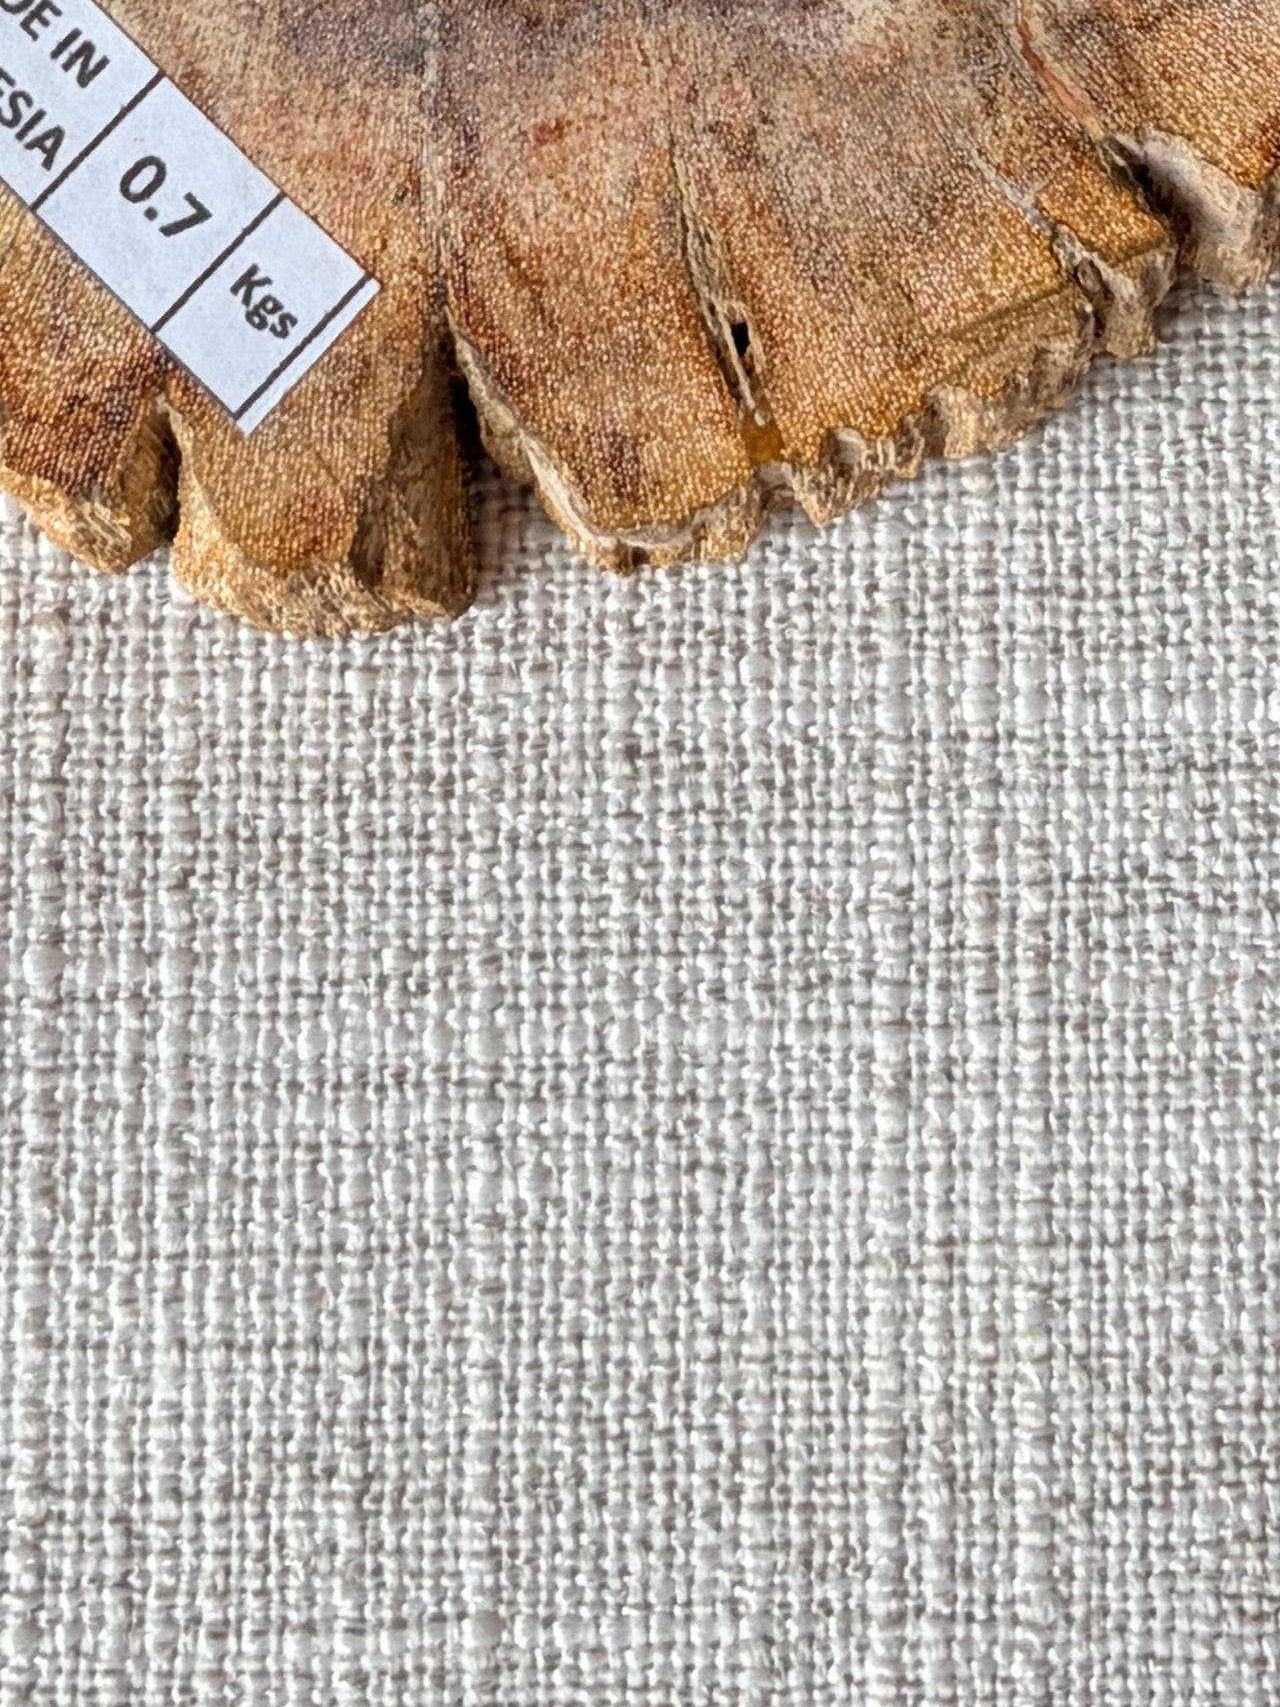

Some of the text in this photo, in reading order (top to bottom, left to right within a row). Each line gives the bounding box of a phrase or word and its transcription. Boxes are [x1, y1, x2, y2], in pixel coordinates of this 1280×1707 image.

[52, 27, 111, 90] IN
[120, 154, 213, 240] 0.7
[230, 262, 300, 341] Kgs
